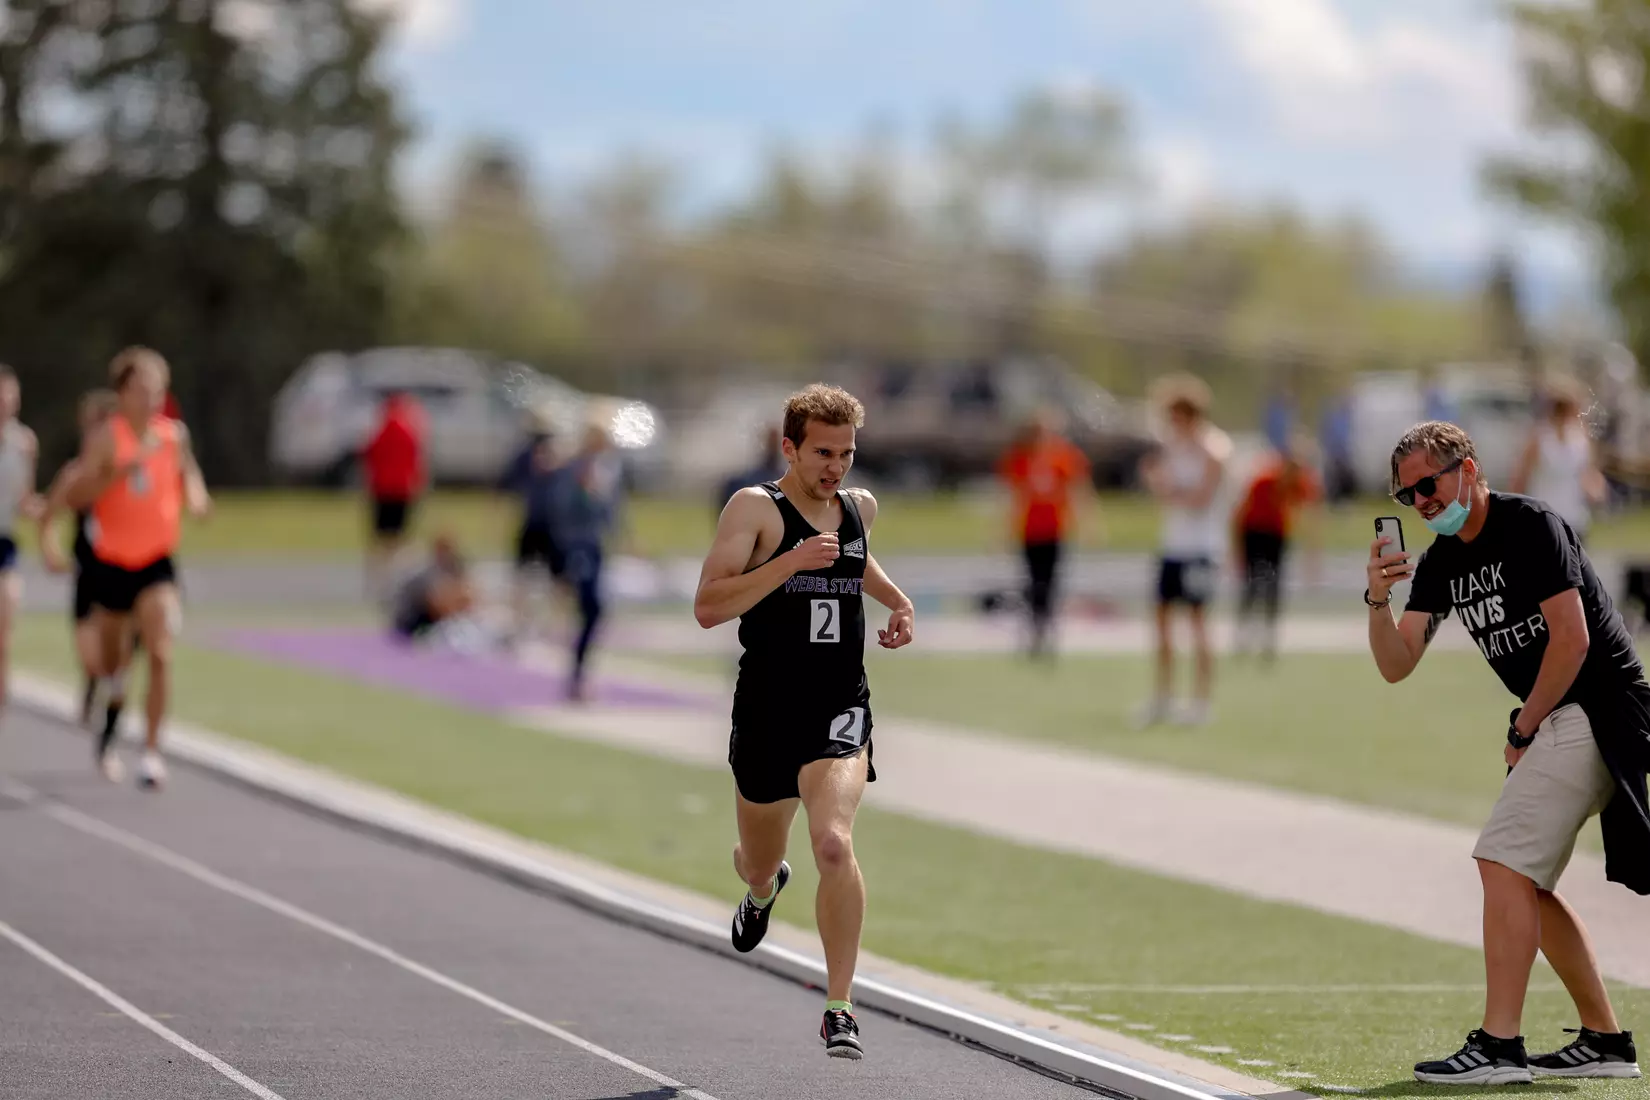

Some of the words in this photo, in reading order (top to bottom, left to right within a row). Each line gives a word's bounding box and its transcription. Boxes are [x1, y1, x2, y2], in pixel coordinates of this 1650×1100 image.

[785, 575, 829, 593] WEBER
[816, 602, 835, 640] 2
[836, 710, 856, 742] 2
